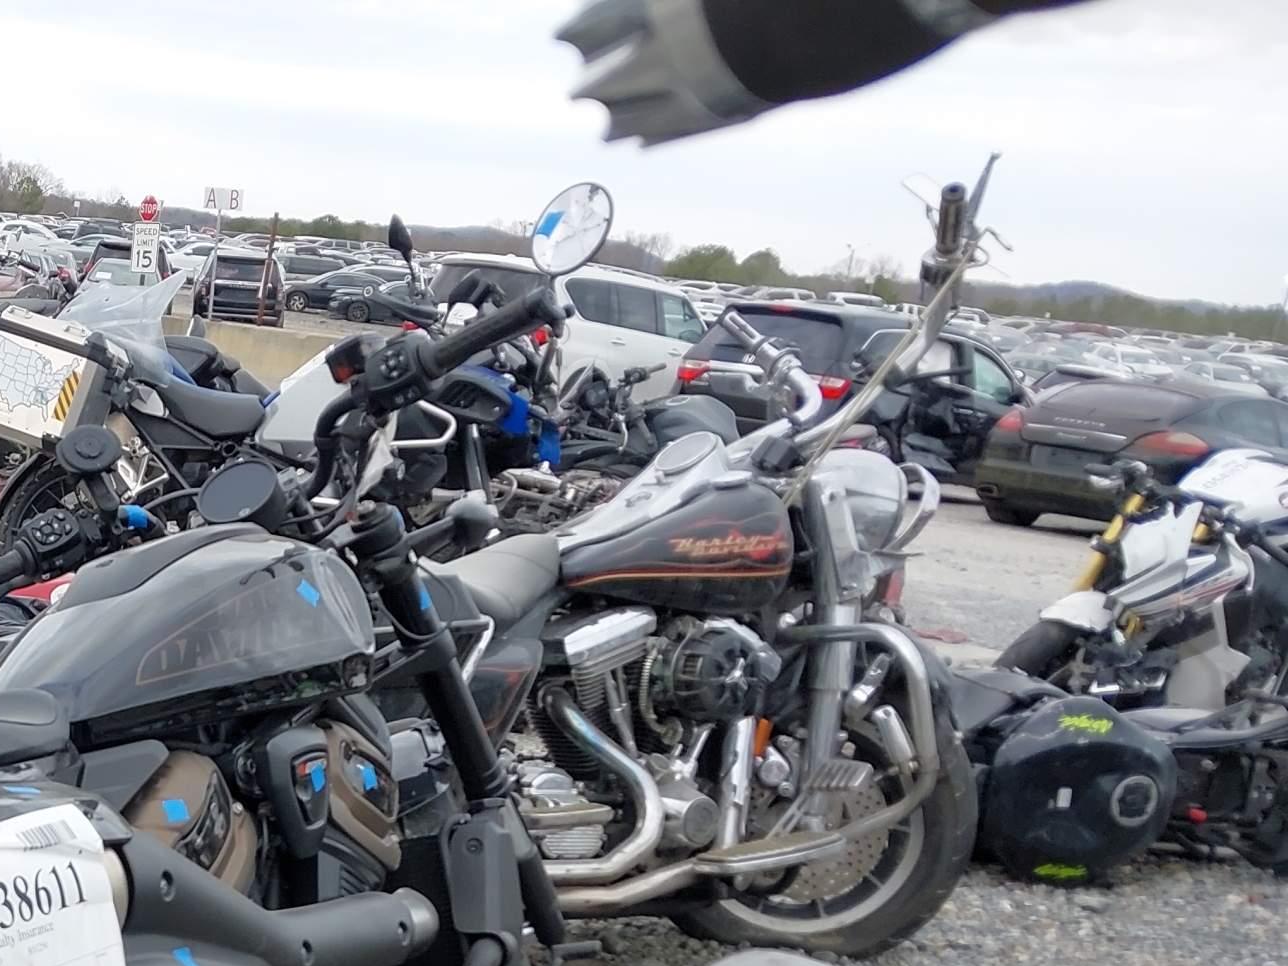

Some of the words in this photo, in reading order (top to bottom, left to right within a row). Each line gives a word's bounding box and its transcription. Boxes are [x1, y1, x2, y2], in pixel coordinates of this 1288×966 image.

[206, 187, 217, 209] A
[230, 189, 240, 210] B
[140, 203, 158, 213] STOP
[135, 227, 158, 236] SPEED
[136, 250, 153, 268] 15
